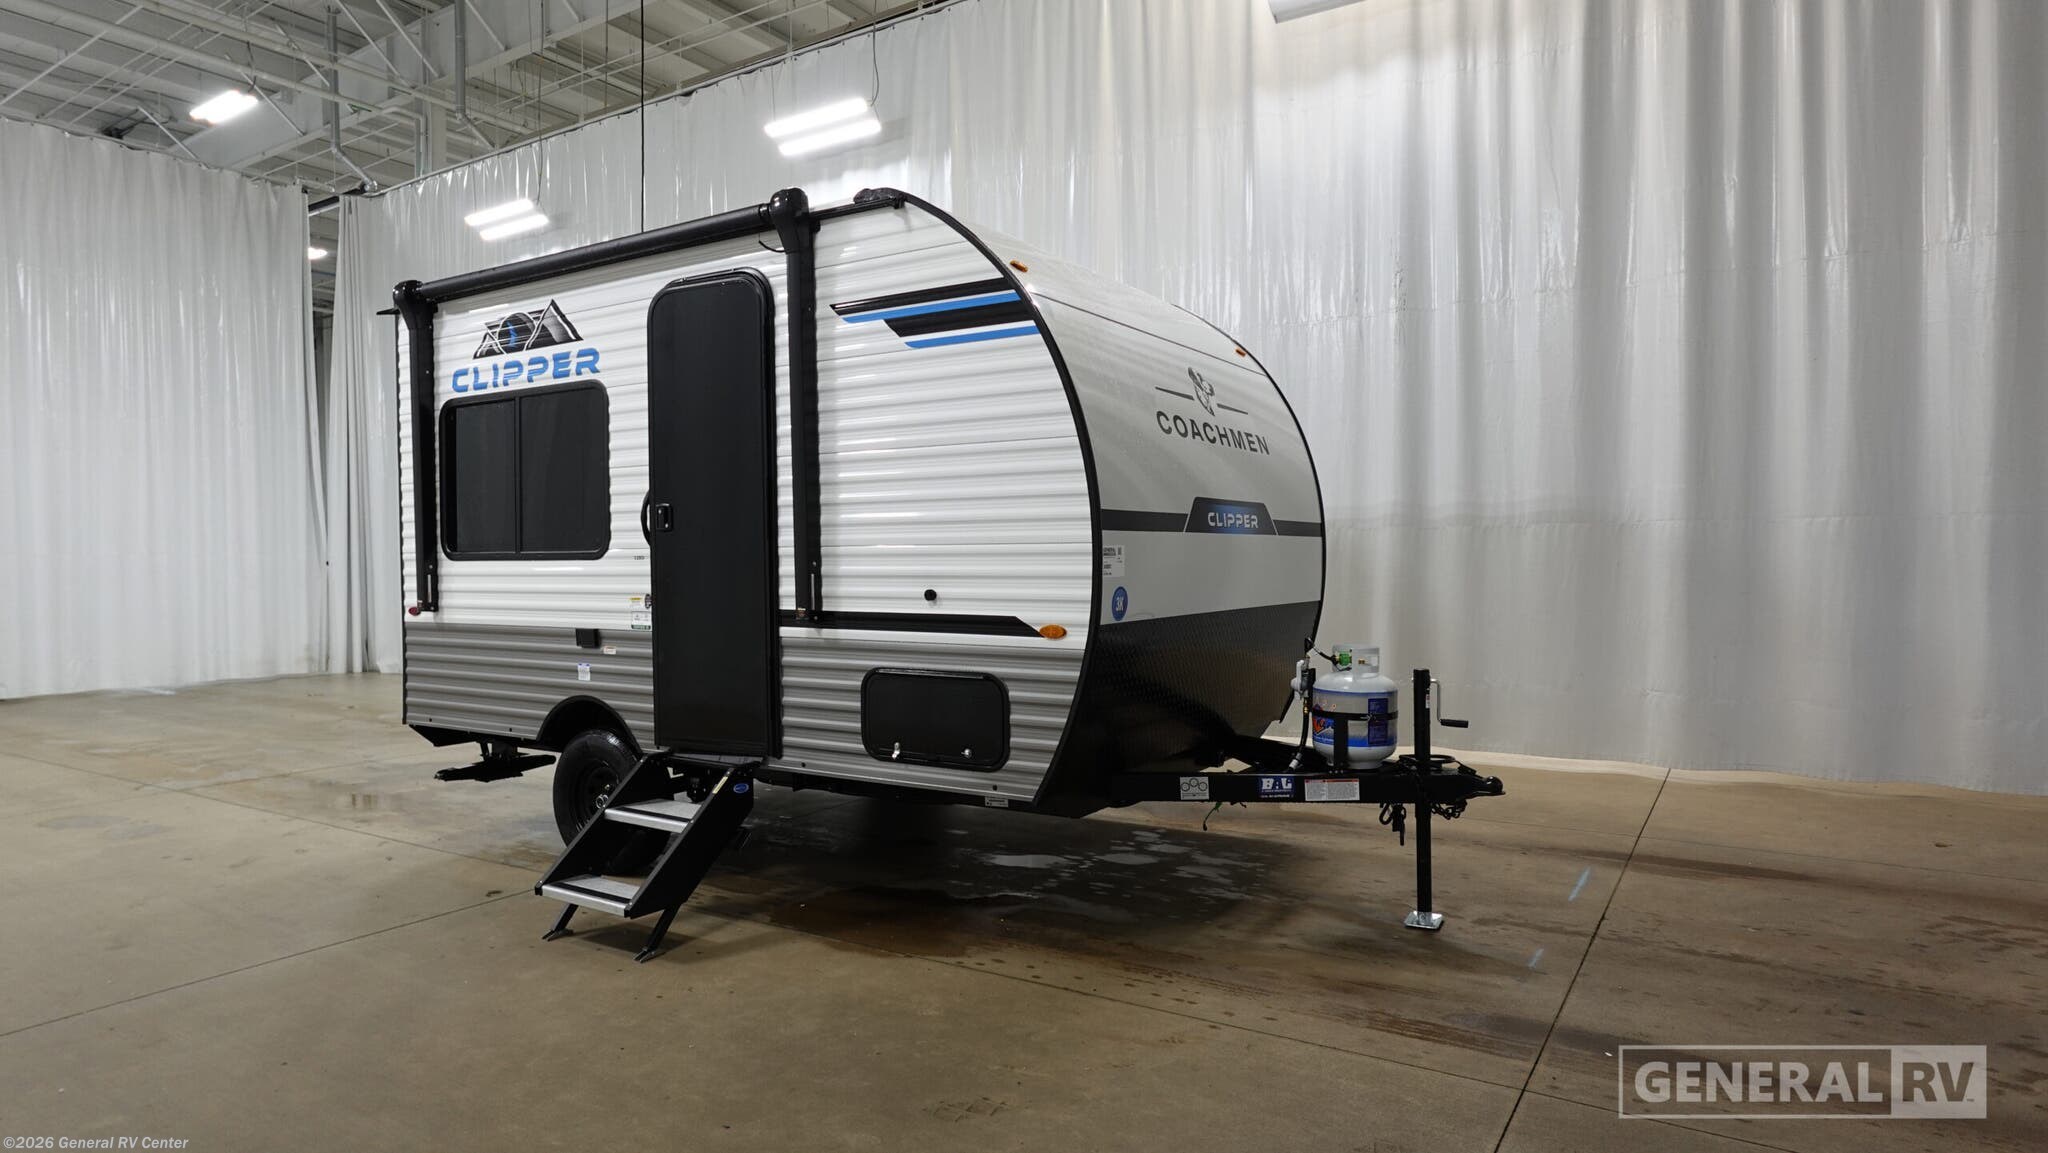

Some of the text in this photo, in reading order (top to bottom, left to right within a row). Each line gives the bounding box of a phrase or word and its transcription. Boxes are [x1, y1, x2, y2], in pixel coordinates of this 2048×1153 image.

[452, 348, 600, 393] CLIPPER
[1157, 411, 1270, 455] COACHMEN
[1207, 511, 1259, 529] CLIPPER
